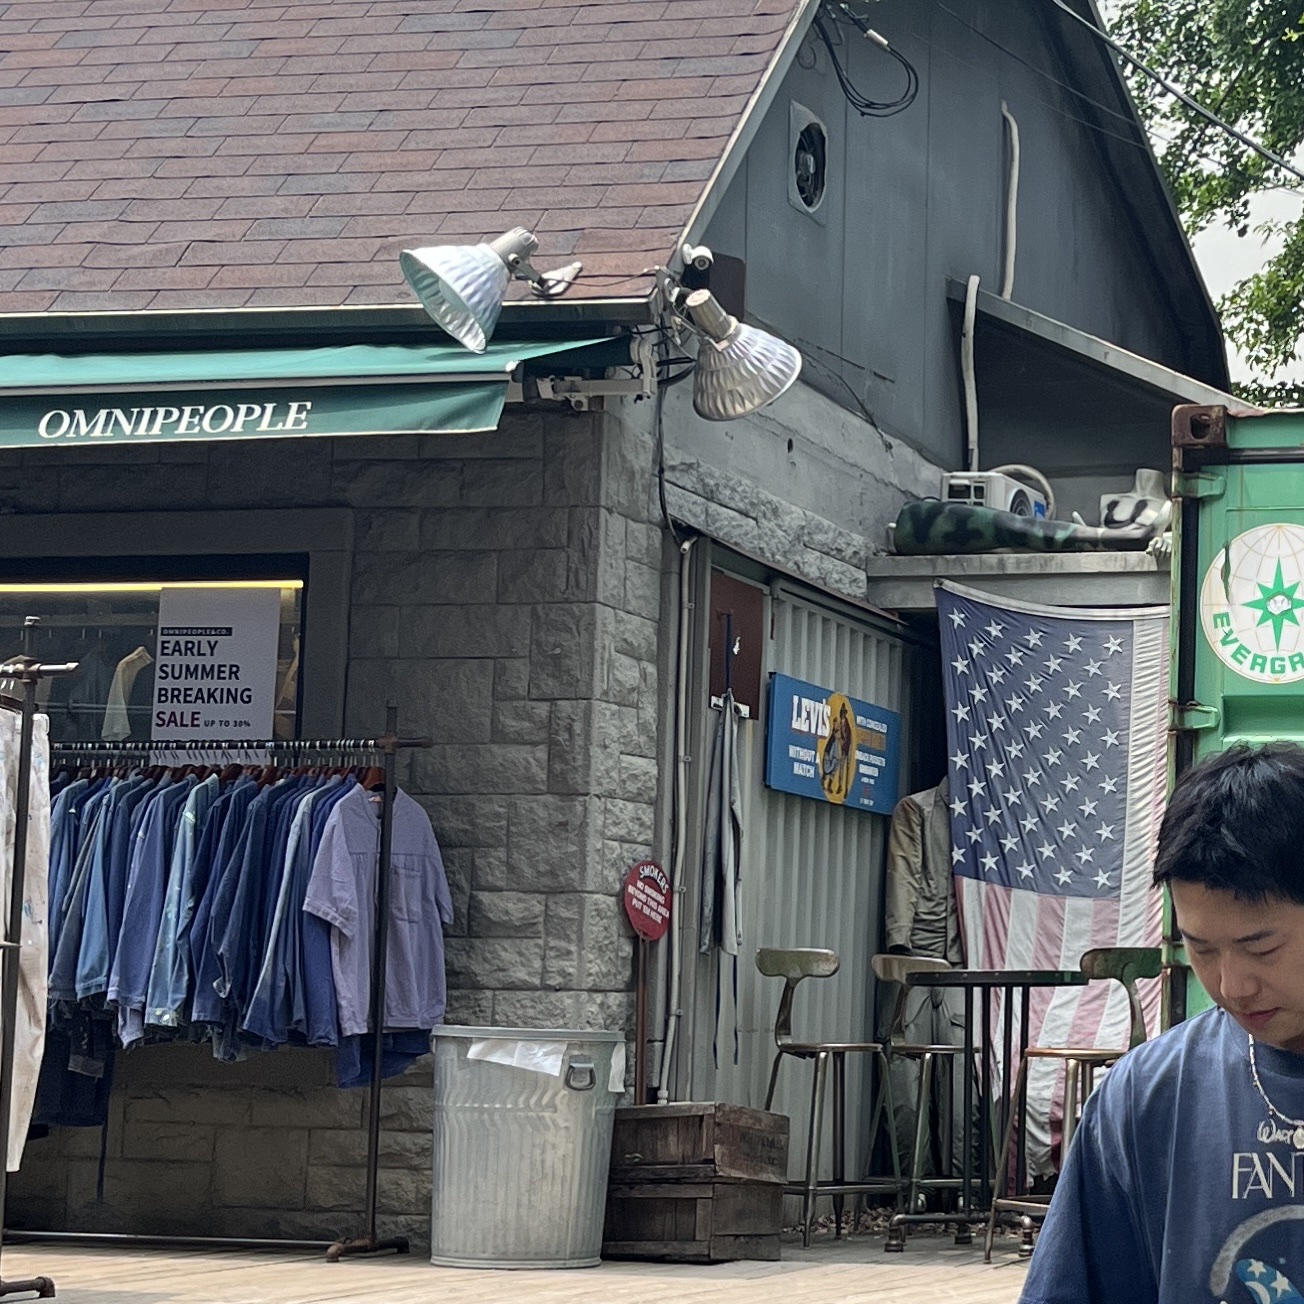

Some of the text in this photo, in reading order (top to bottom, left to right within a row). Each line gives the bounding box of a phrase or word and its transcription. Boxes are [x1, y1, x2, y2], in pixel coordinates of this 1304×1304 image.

[38, 401, 312, 439] OMNIPEOPLE
[160, 640, 219, 657] EARLY
[158, 663, 241, 681] SUMMER
[157, 687, 253, 704] BREAKING
[155, 710, 202, 728] SALE
[203, 719, 216, 728] UP
[218, 719, 231, 728] TO
[639, 865, 669, 894] SMOKERS
